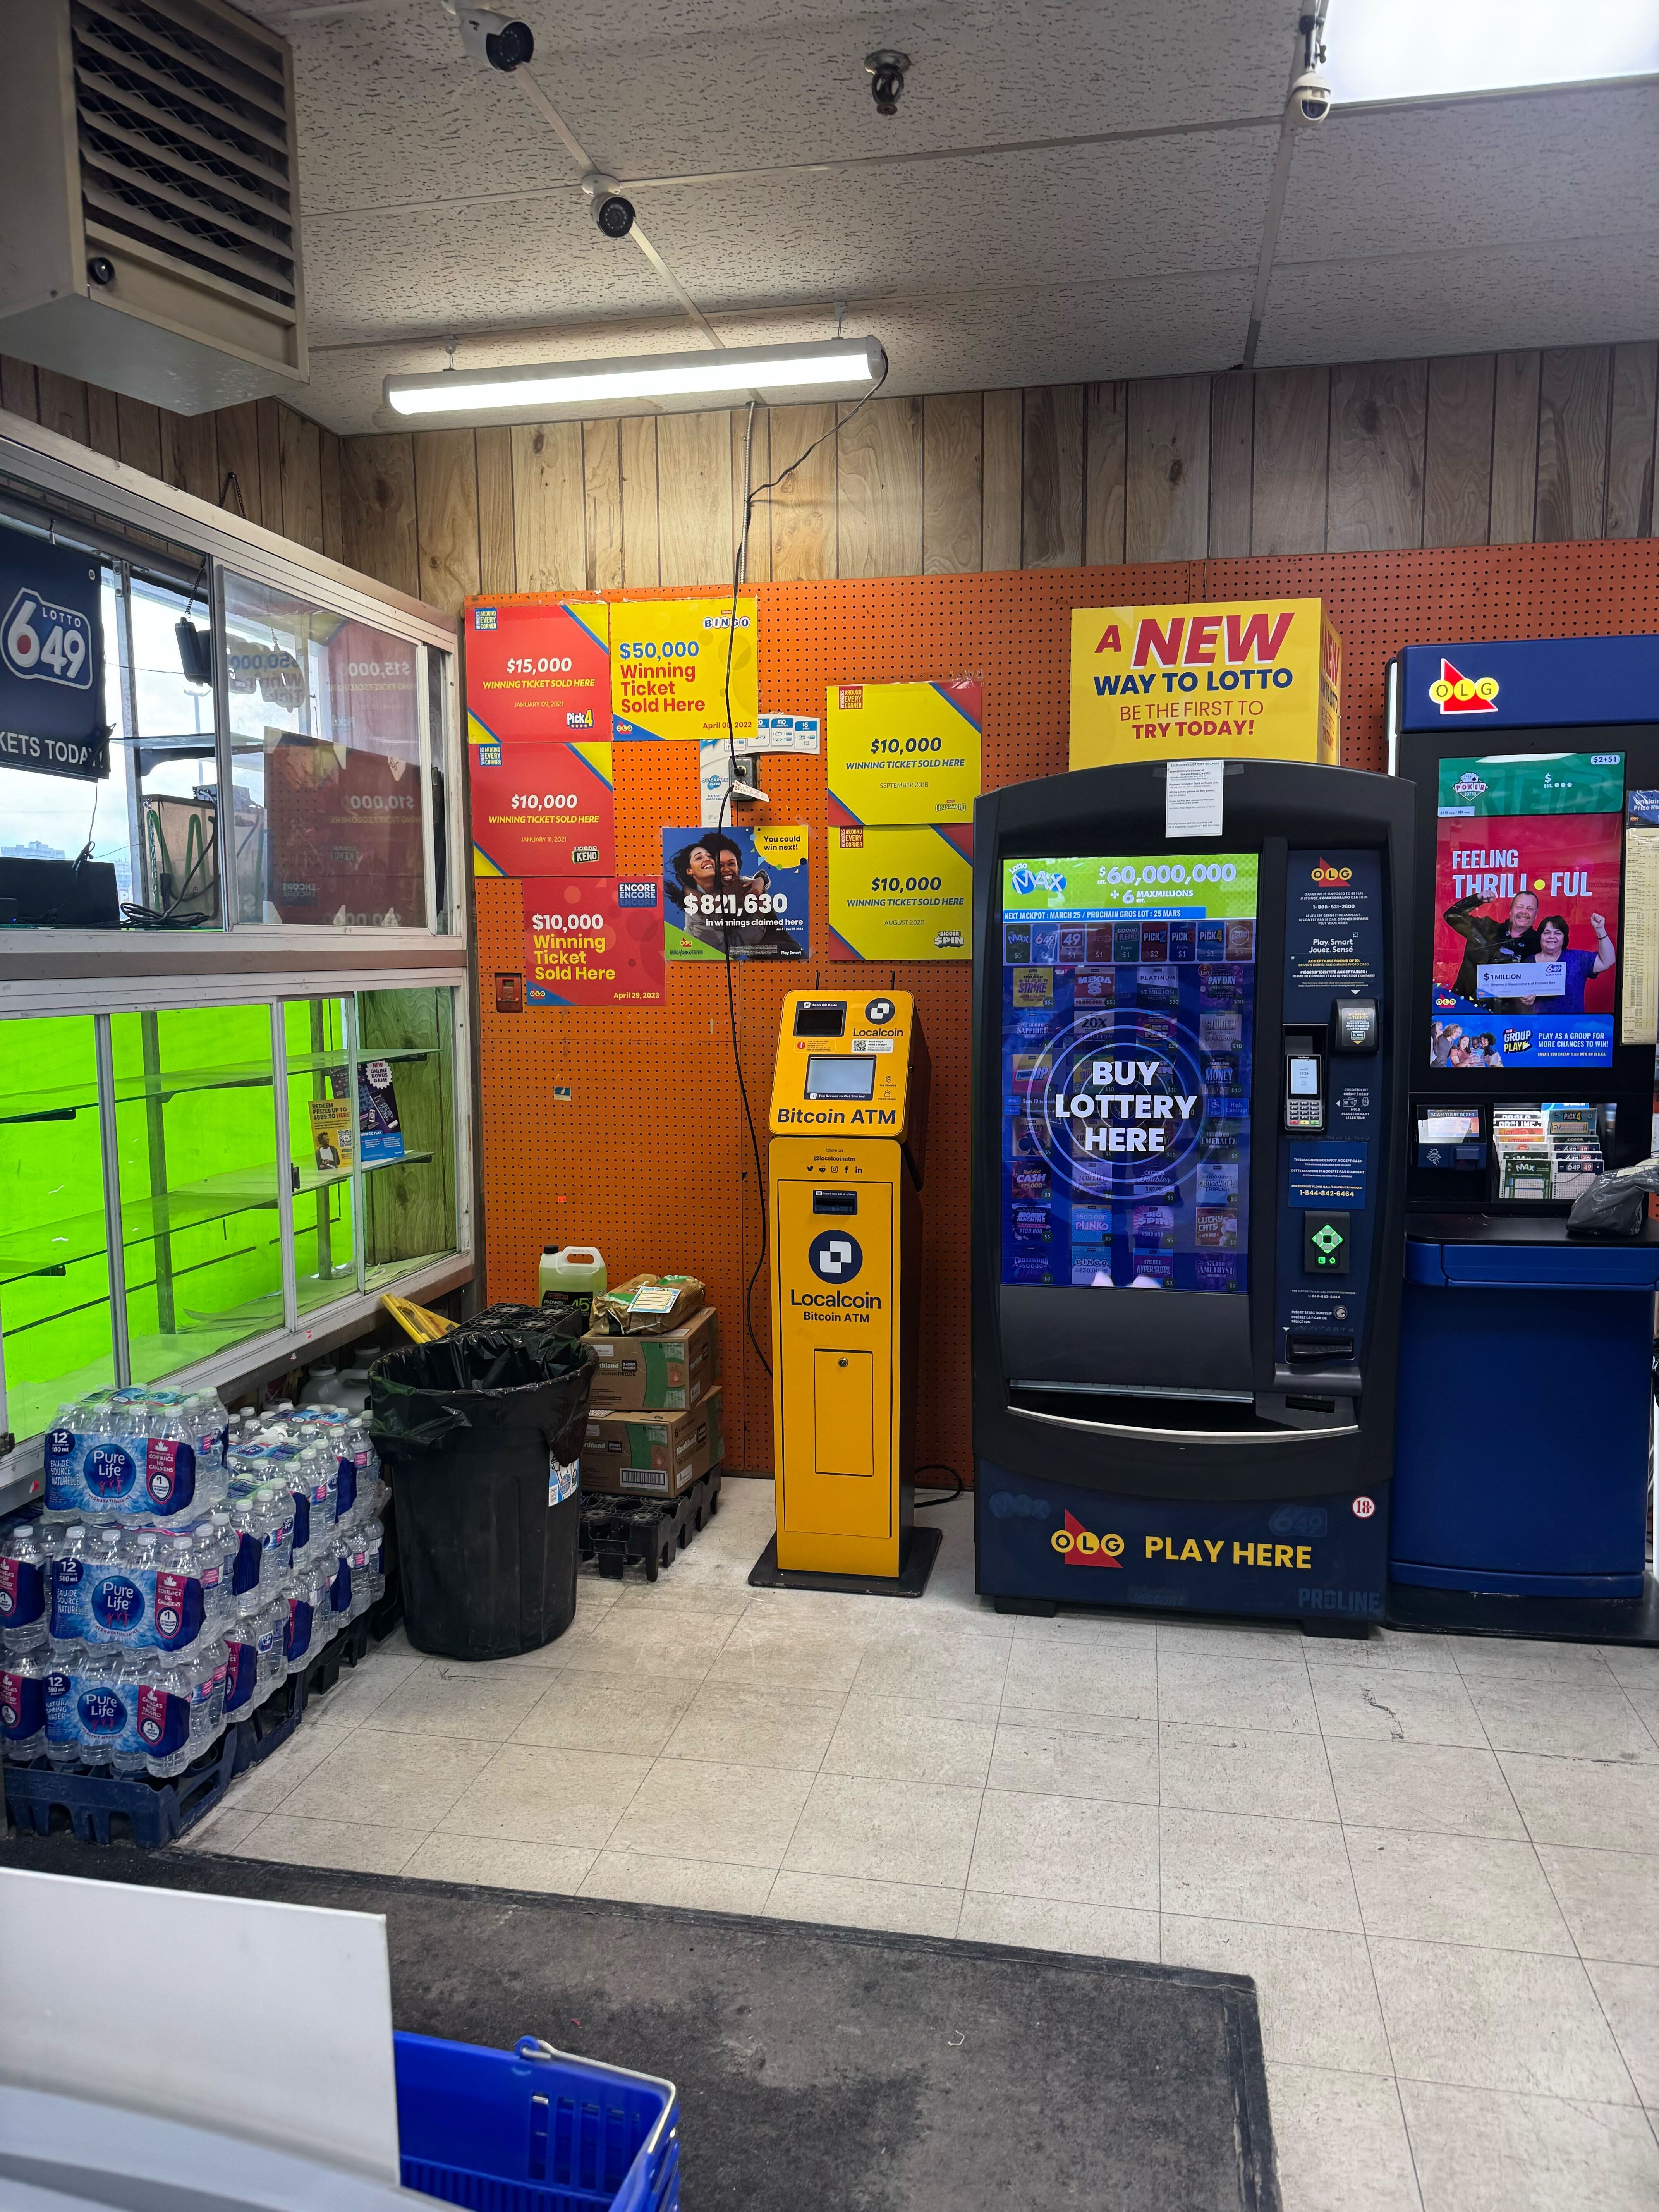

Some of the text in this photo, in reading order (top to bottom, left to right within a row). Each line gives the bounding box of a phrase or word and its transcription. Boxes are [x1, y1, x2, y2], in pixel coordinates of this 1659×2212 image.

[43, 606, 81, 628] LOTTO
[704, 617, 750, 629] BINGO
[1095, 612, 1295, 669] A NEW
[620, 641, 699, 662] $50,000
[507, 657, 572, 676] $15,000
[621, 663, 696, 683] Winning
[522, 680, 550, 688] TICKET
[574, 678, 594, 687] HERE
[621, 681, 675, 696] Ticket
[1094, 668, 1293, 696] WAY TO LOTTO
[1432, 681, 1496, 700] OLG
[622, 697, 705, 713] Sold Here
[1120, 701, 1263, 721] BE THE FIRST TO
[1132, 720, 1254, 739] TRY TODAY!
[871, 737, 942, 755] $10,000
[846, 761, 884, 769] WINNING
[887, 760, 915, 768] TICKET
[1455, 783, 1486, 792] POKER
[511, 794, 577, 811] $10,000
[489, 816, 526, 824] WINNING
[578, 815, 599, 823] HERE
[577, 852, 597, 861] KENO
[1453, 849, 1518, 869] FEELING
[1008, 863, 1027, 874] Lotto
[1312, 869, 1351, 879] OLG
[871, 876, 941, 893] $10,000
[1013, 870, 1065, 894] MAX
[684, 893, 787, 917] $821,630
[1123, 890, 1134, 904] 6
[532, 914, 603, 933] $10,000
[533, 934, 605, 953] Winning
[534, 950, 586, 965] Ticket
[535, 966, 615, 980] Sold Here
[613, 992, 630, 1000] April
[853, 1028, 903, 1037] Localcoin
[1092, 1061, 1160, 1085] BUY
[1055, 1094, 1197, 1119] LOTTERY
[777, 1108, 896, 1124] Bitcoin ATM
[1085, 1127, 1165, 1152] HERE
[1016, 1174, 1046, 1182] CASH
[1197, 1216, 1223, 1224] LUCKY
[791, 1289, 881, 1309] Localcoin
[804, 1311, 869, 1322] Bitcoin ATM
[53, 1433, 68, 1443] 12
[676, 1434, 696, 1456] Northland
[94, 1451, 125, 1465] Pure
[51, 1467, 70, 1475] SOURCE
[98, 1465, 121, 1478] Life
[1054, 1533, 1121, 1554] OLG
[1146, 1536, 1312, 1569] PLAY HERE
[61, 1561, 76, 1572] 12
[103, 1582, 133, 1599] Pure
[107, 1596, 129, 1611] Life
[86, 1694, 117, 1707] Pure
[91, 1706, 114, 1717] Life
